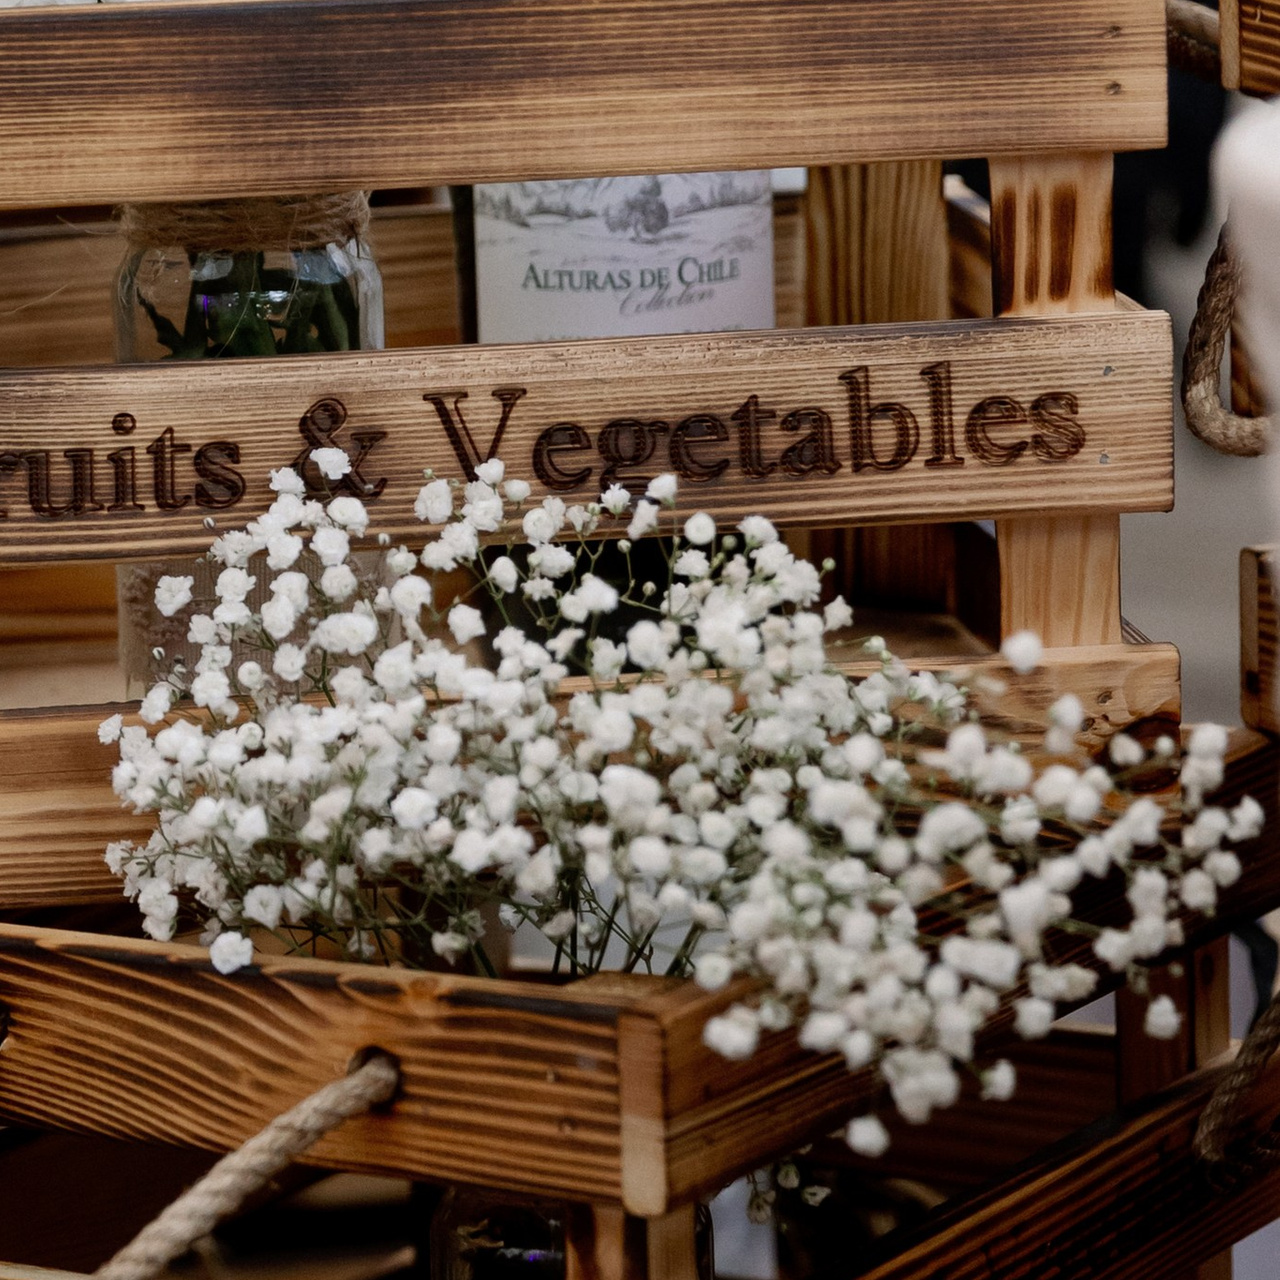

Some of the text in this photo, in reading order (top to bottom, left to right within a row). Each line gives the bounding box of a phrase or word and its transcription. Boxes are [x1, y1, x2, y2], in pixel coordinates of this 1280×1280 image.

[522, 262, 631, 292] ALTURAS
[676, 256, 740, 287] CHILE
[290, 397, 388, 500] &
[421, 360, 1087, 516] Vegetables
